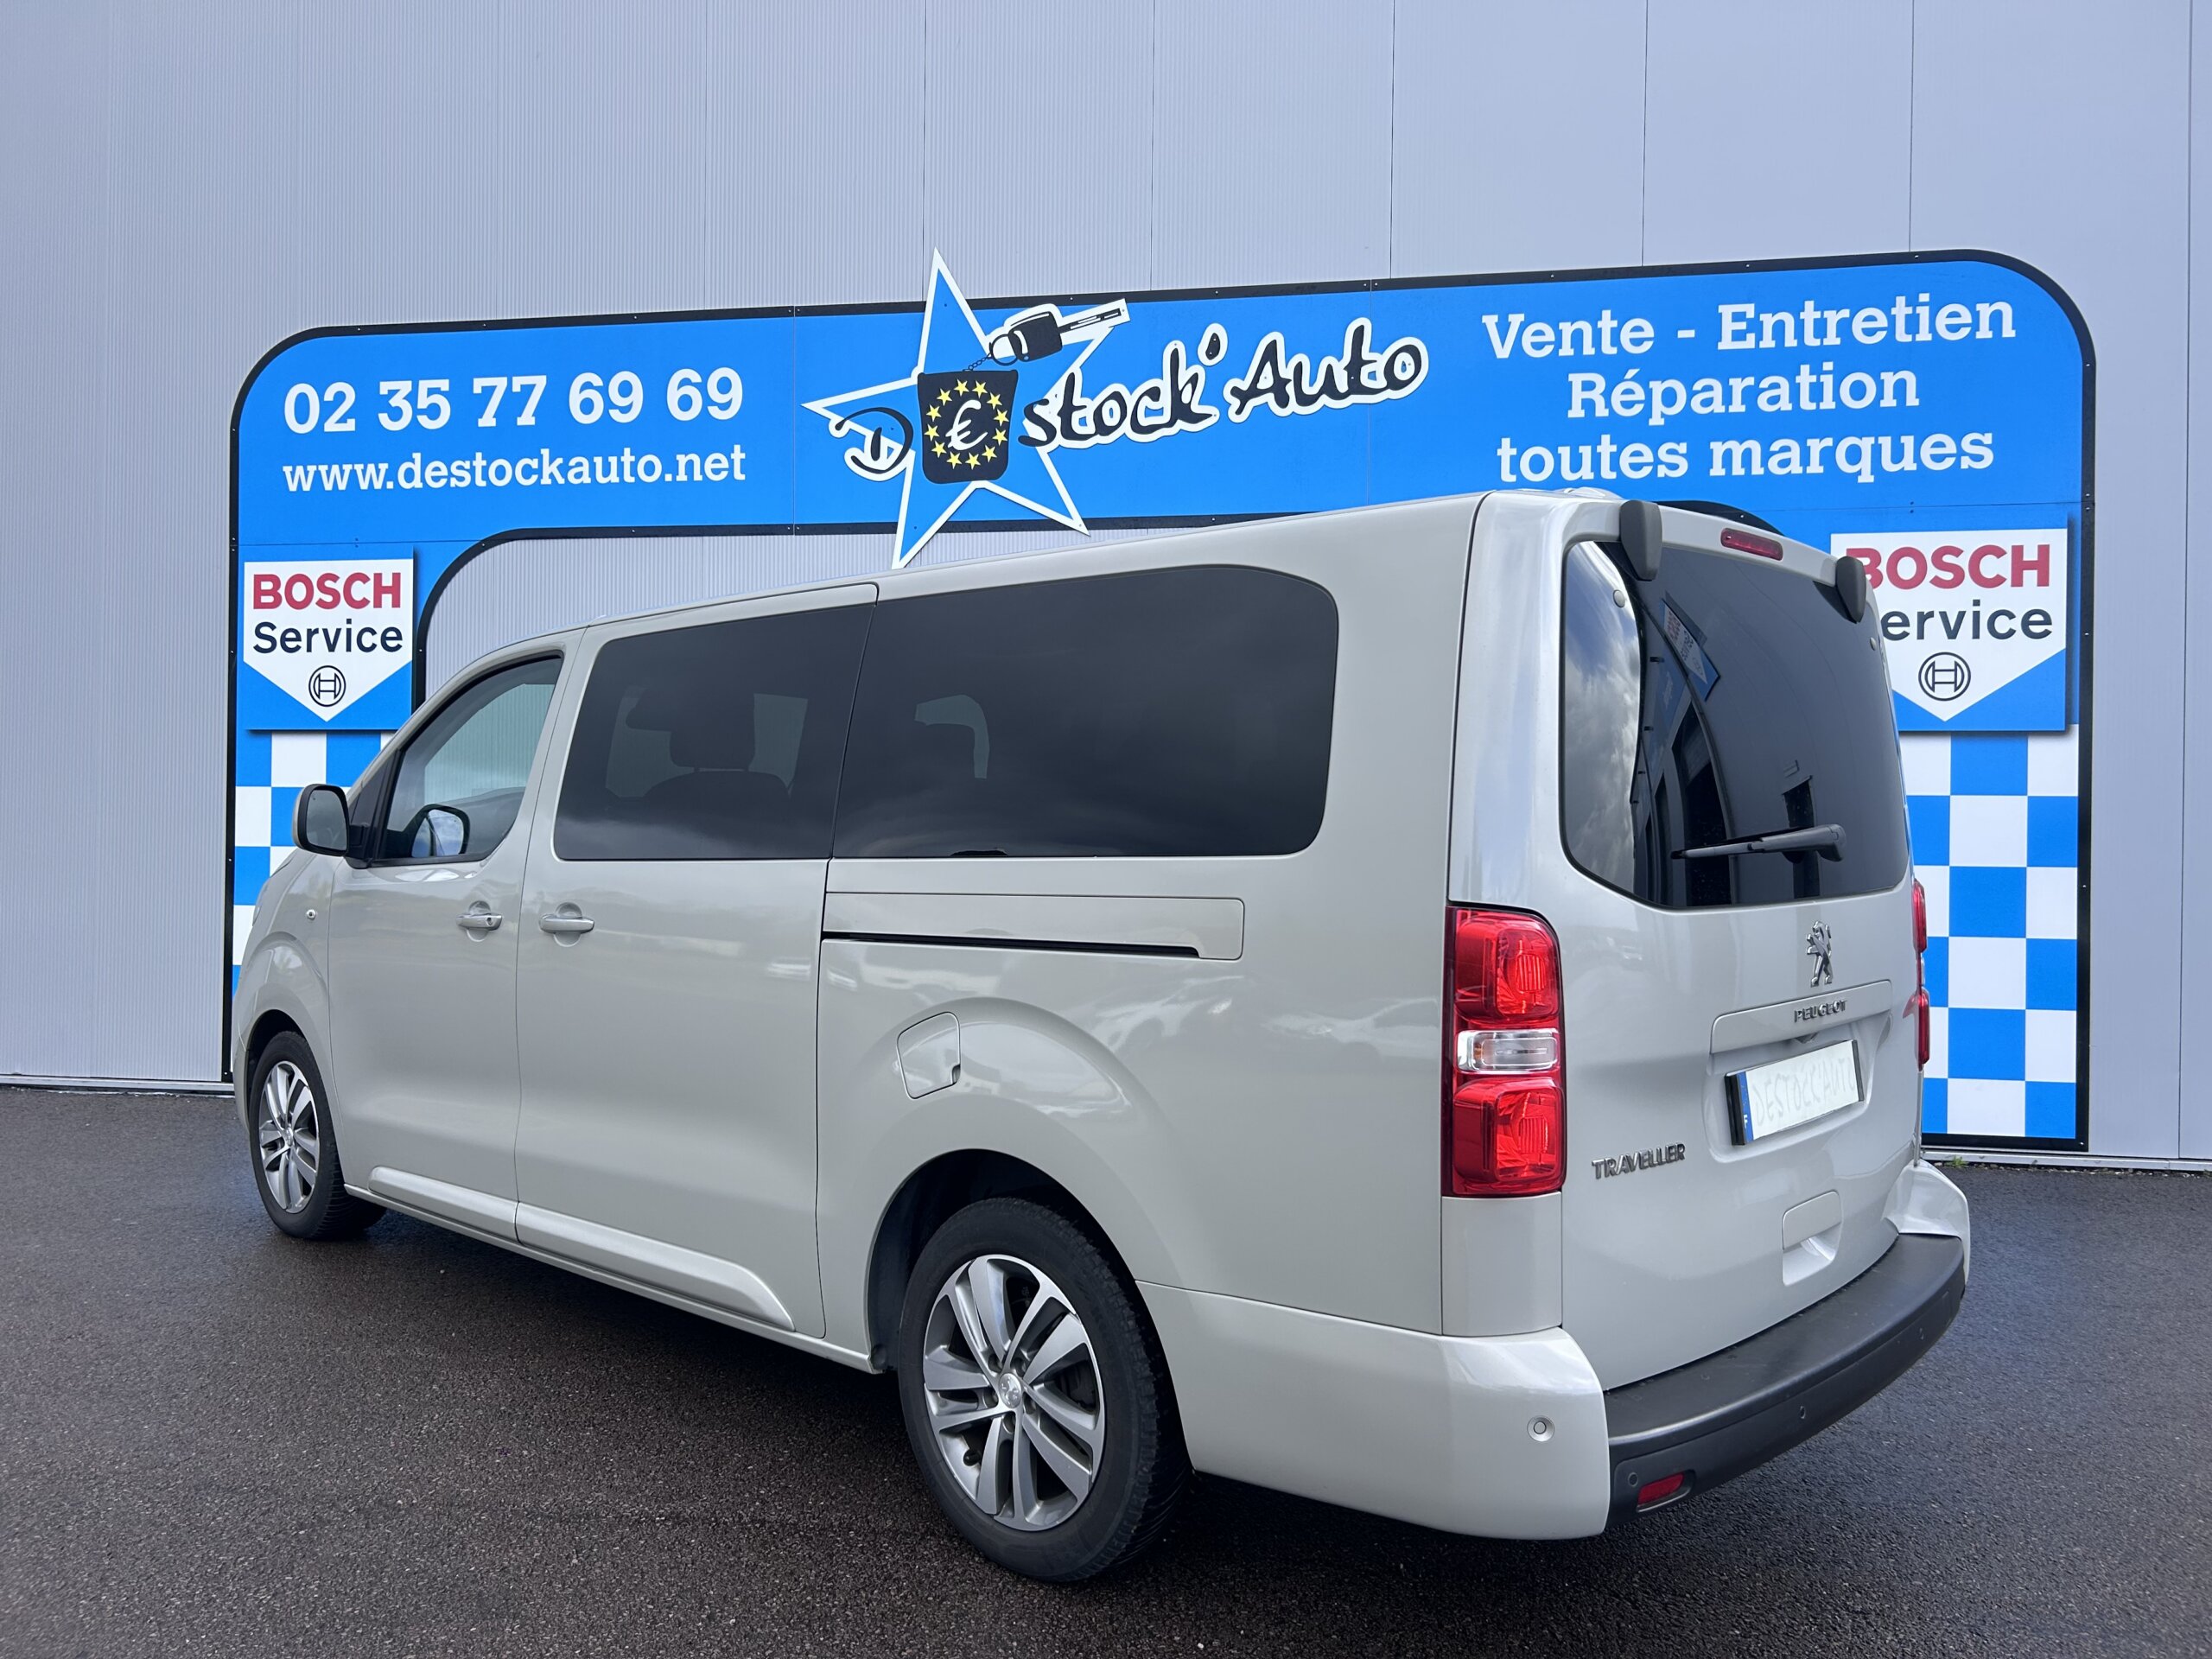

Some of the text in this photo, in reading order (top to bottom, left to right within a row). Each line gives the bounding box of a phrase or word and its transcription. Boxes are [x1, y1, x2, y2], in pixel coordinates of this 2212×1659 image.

[1482, 310, 1655, 359] Vente
[1718, 293, 2016, 350] Entretien
[284, 366, 743, 434] 02 35 77 69 69
[1567, 361, 1920, 426] Réparation
[283, 444, 746, 492] www.destockauto.net
[1497, 432, 1994, 483] toutes marques
[252, 572, 401, 610] BOSCH
[252, 619, 403, 654] Service
[1879, 599, 2053, 641] ervice
[1794, 999, 1847, 1023] PEUGEOT
[1592, 1142, 1686, 1179] TRAVELLER
